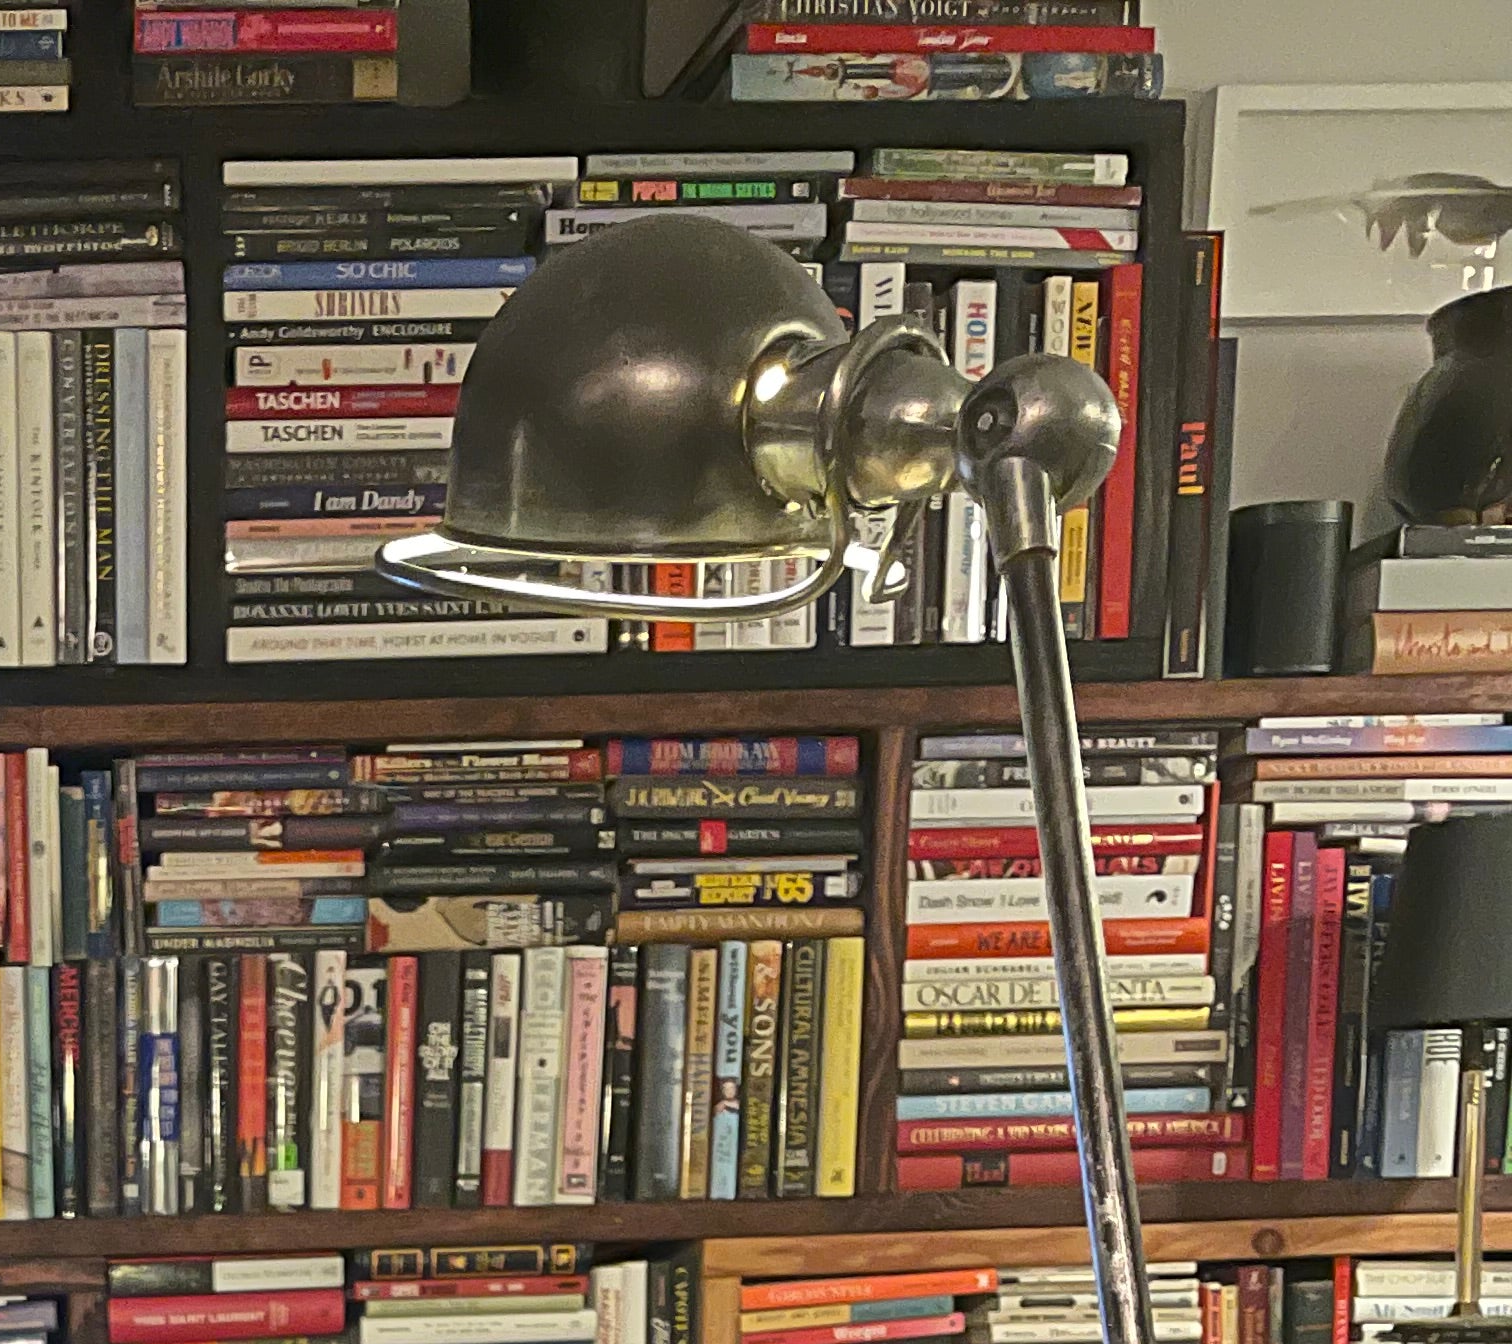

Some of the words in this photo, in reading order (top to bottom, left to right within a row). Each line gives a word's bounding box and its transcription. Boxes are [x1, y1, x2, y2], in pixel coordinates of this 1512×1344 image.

[255, 391, 341, 411] TASCHEN
[261, 424, 344, 443] TASCHEN
[361, 489, 426, 515] Dandy
[917, 983, 1002, 1008] OSCAR
[1008, 981, 1042, 1004] DE
[750, 996, 776, 1078] SONS
